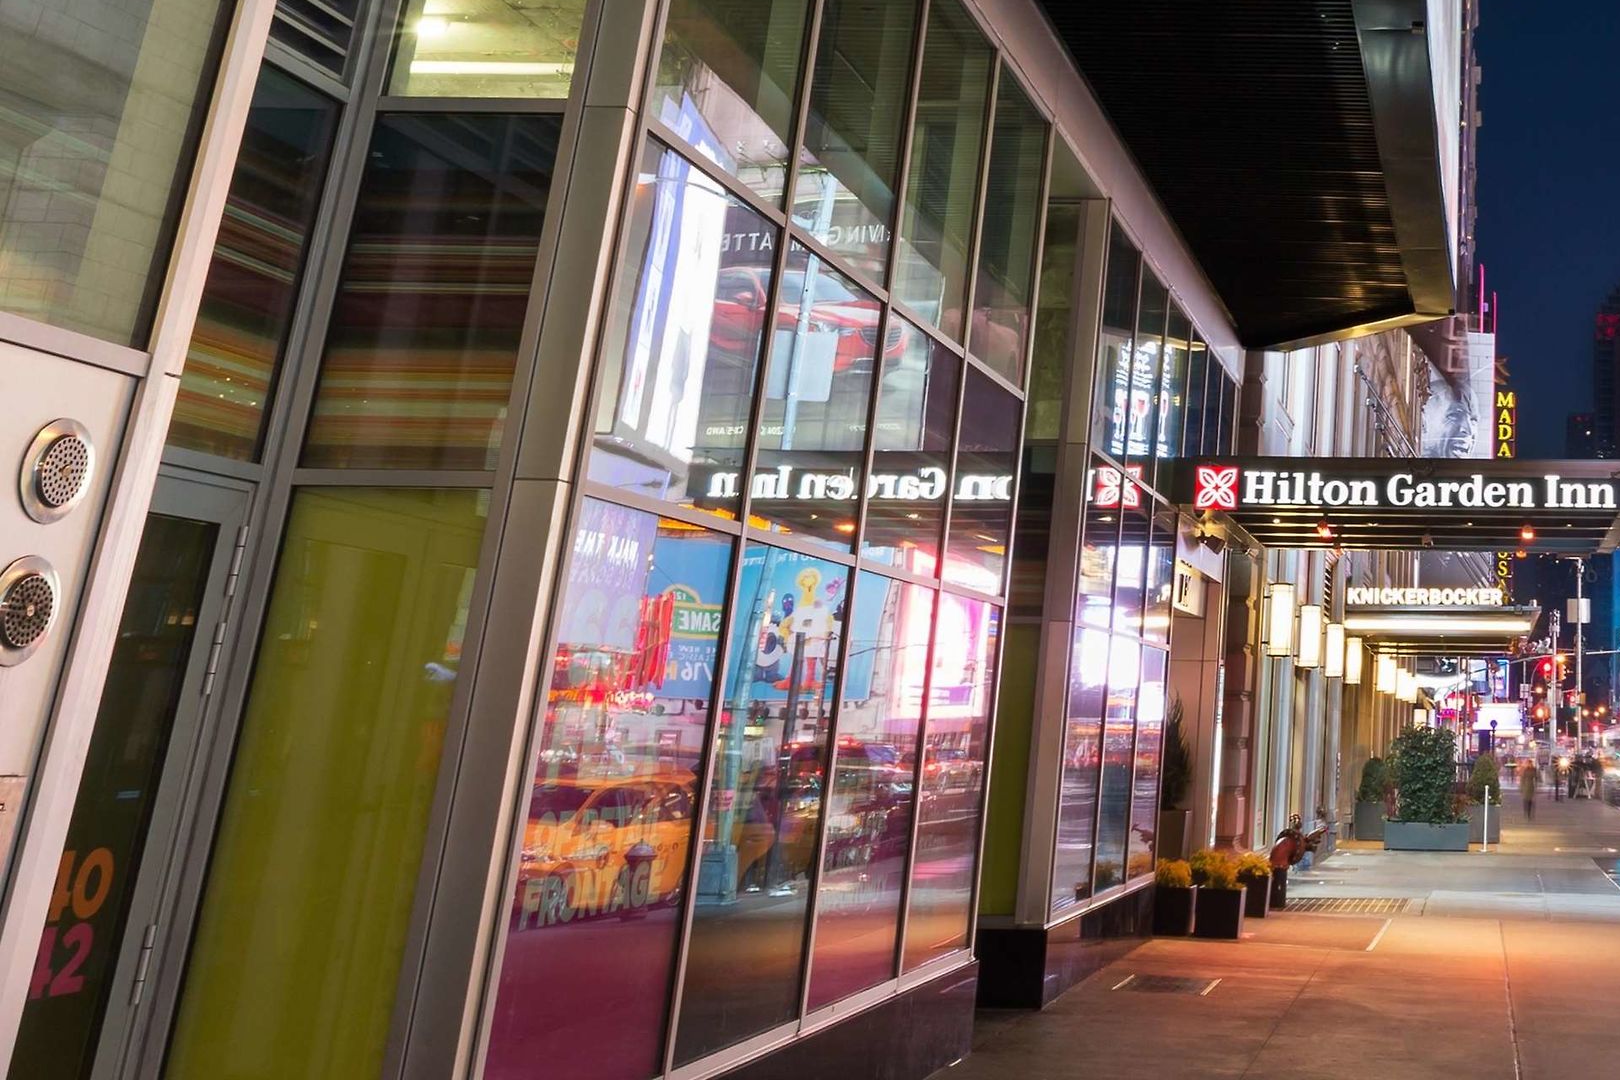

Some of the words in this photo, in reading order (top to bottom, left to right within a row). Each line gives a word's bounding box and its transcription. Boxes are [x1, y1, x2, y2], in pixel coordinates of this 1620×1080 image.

[1242, 470, 1378, 506] Hilton
[1387, 474, 1536, 509] Garden
[1543, 475, 1618, 509] Inn
[1347, 587, 1504, 606] KNICKERBOCKER
[518, 860, 665, 932] FRONTAGE
